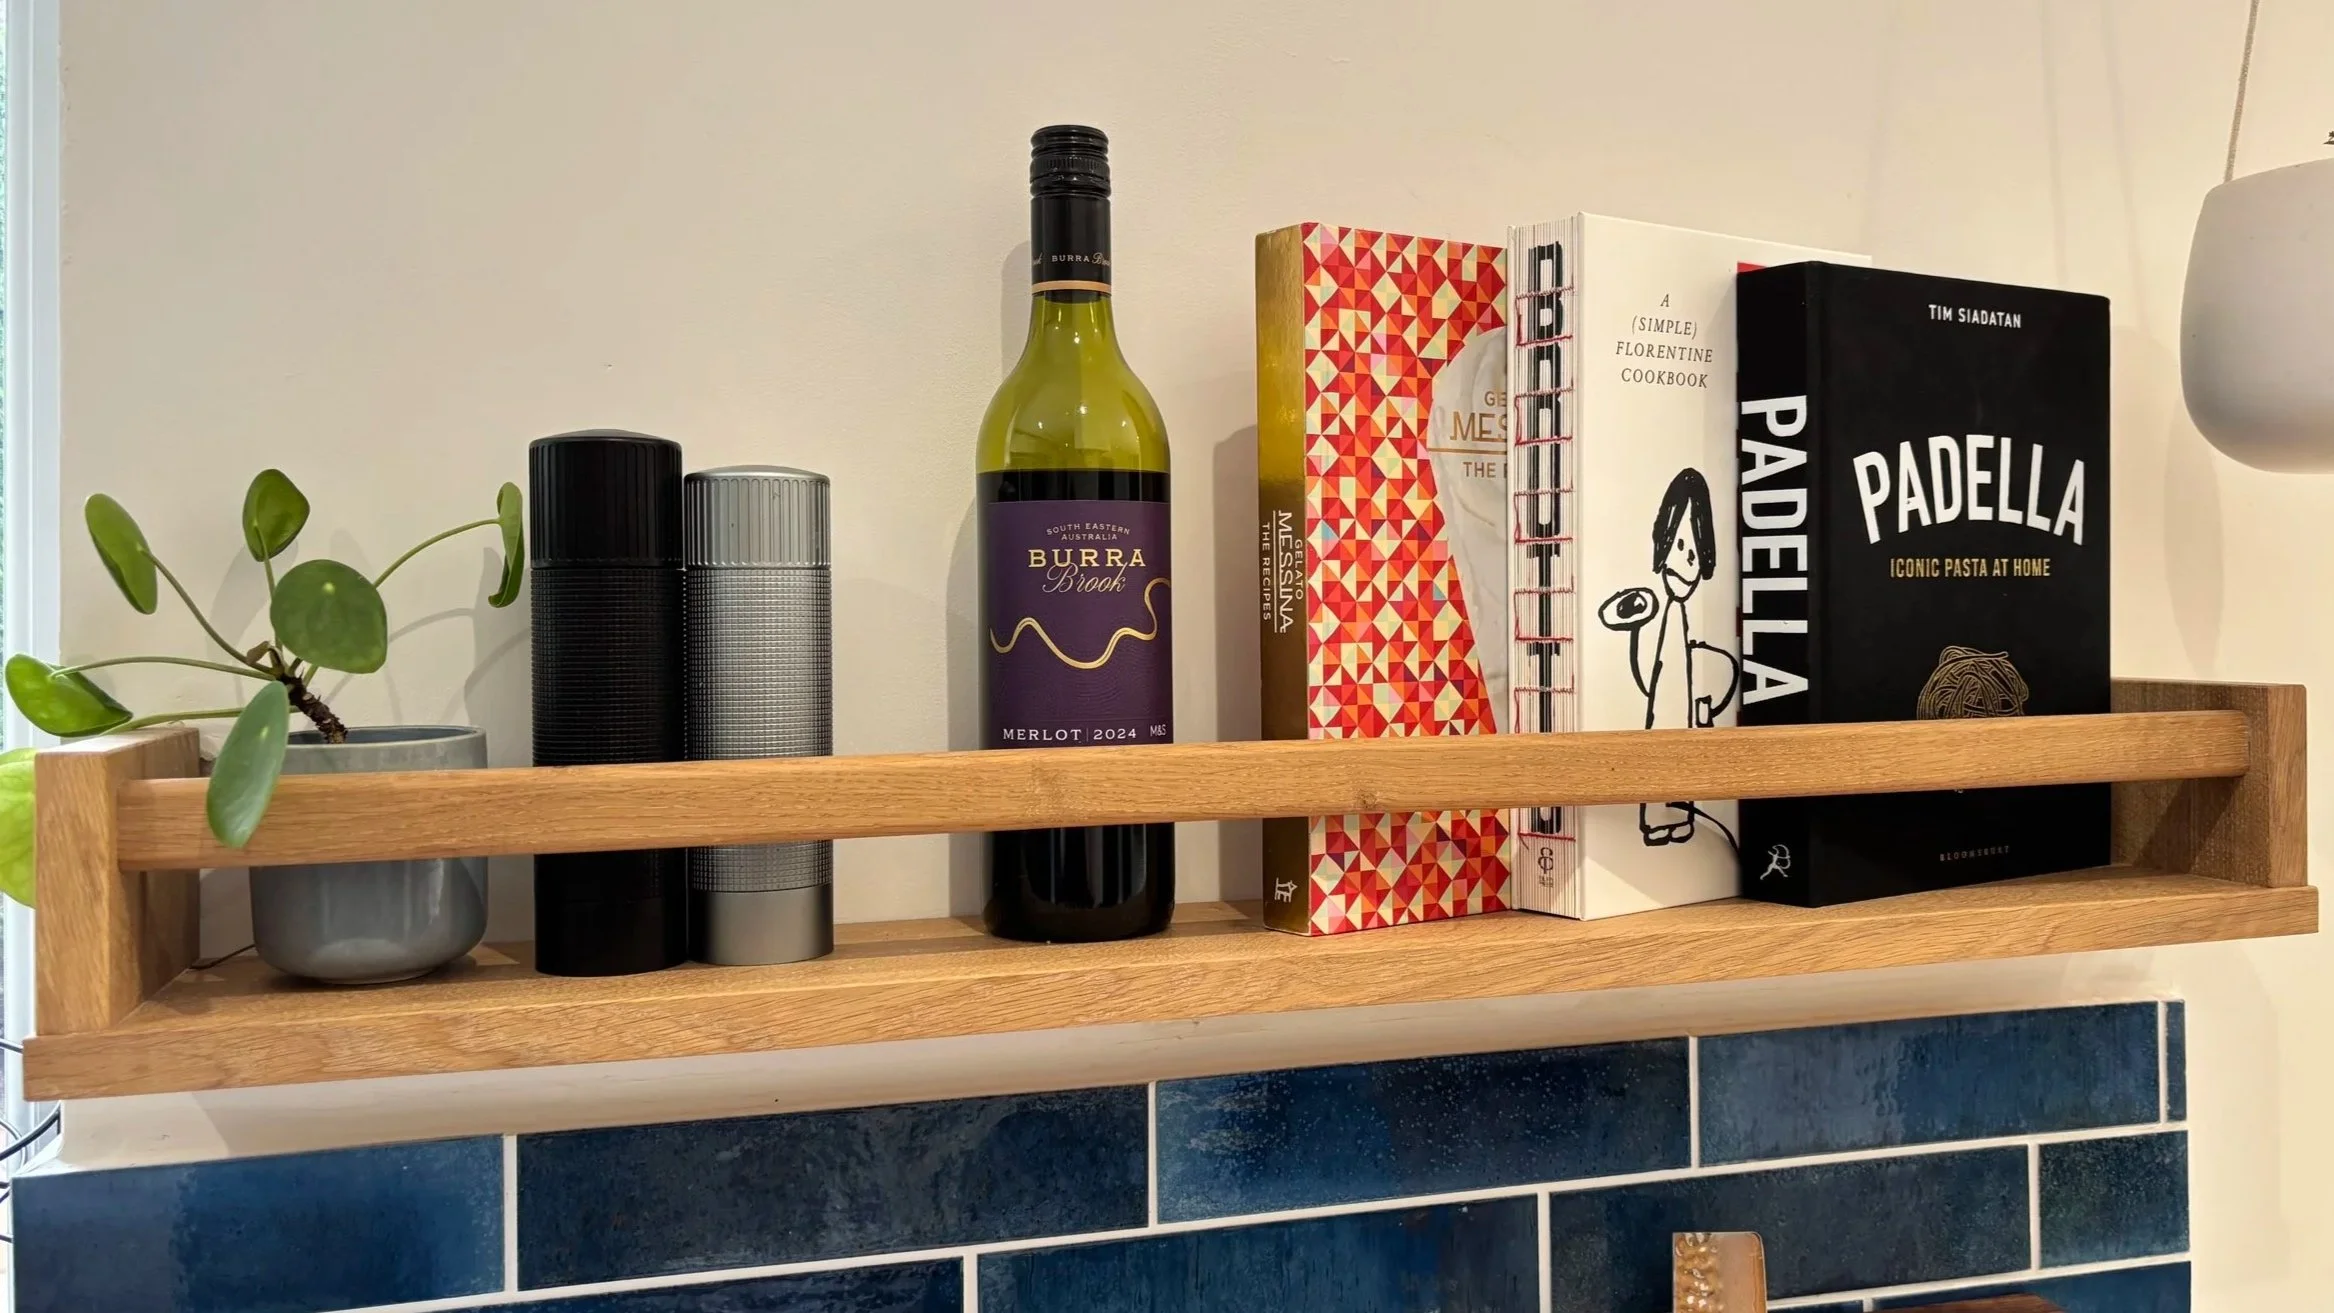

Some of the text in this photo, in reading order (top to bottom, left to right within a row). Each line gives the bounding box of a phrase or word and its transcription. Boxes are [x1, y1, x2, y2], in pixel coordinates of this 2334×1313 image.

[1051, 254, 1090, 262] BURRA
[1660, 293, 1670, 308] A
[1928, 304, 2022, 329] TIM SIADATAN
[1631, 315, 1697, 340] (SIMPLE)
[1615, 341, 1713, 363] FLORENTINE
[1621, 367, 1708, 388] COOKBOOK
[1462, 461, 1496, 479] THE
[1852, 434, 2085, 546] PADELLA
[1046, 522, 1131, 536] SOUTH EASTERN
[1061, 533, 1118, 541] AUSTRALIA
[1028, 548, 1146, 568] BURRA
[1741, 395, 1808, 705] PADELLA
[1042, 561, 1127, 593] Brook
[1262, 522, 1271, 621] THE RECIPES
[1278, 510, 1294, 634] MESSINA
[1294, 539, 1304, 600] GELATO
[1890, 558, 2051, 578] ICONIC PASTA AT HOME
[1003, 728, 1137, 741] MERLOT 2024
[1150, 724, 1167, 737] M&S
